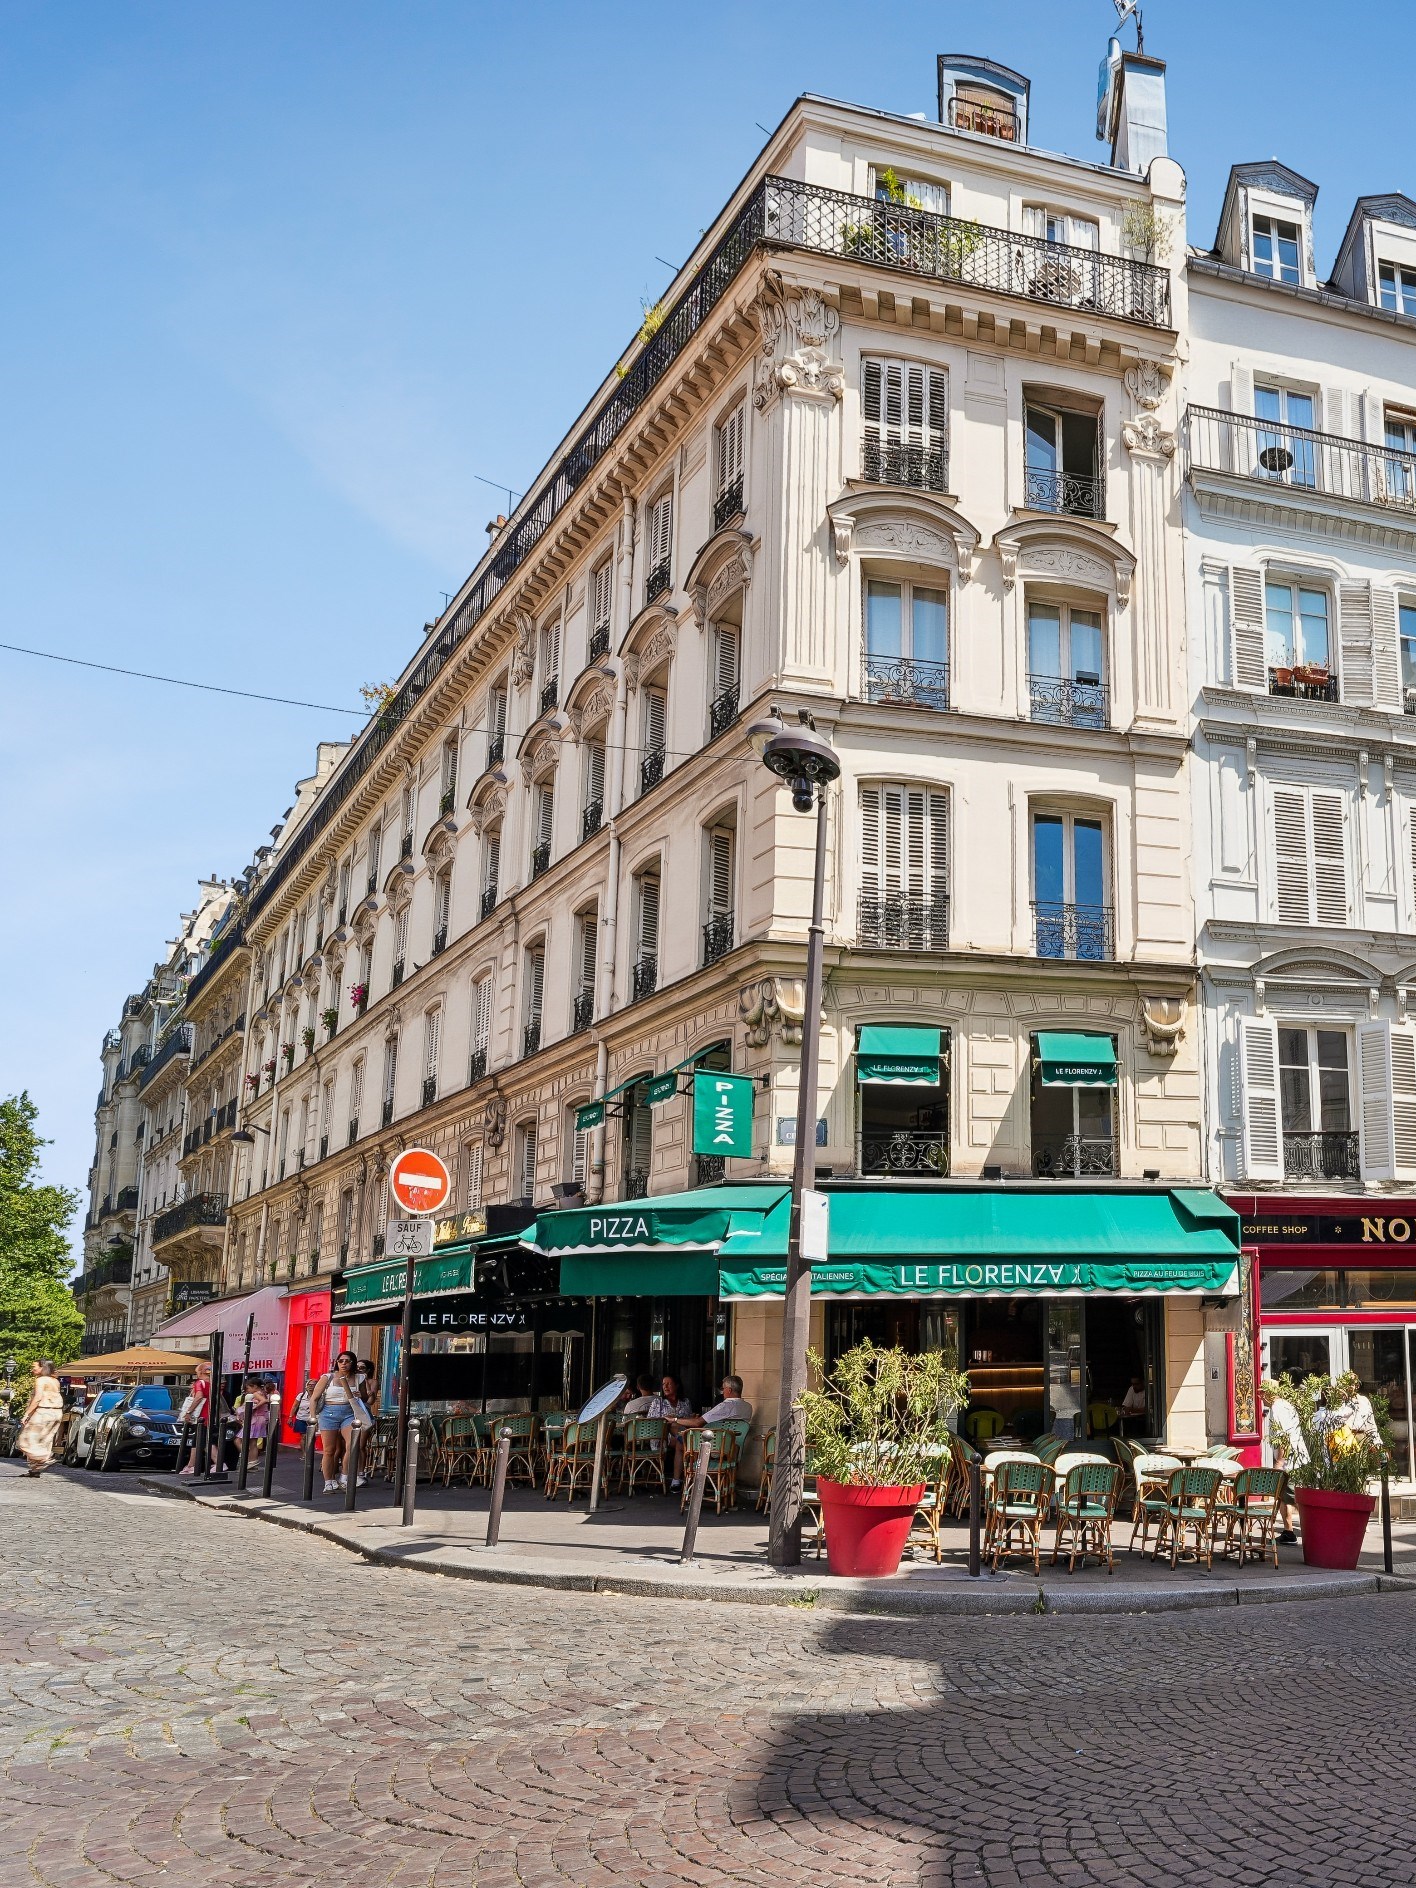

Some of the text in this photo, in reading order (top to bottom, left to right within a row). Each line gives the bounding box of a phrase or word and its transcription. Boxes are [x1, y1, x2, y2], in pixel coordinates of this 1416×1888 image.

[713, 1081, 735, 1145] PIZZA
[397, 1223, 422, 1233] SAUF
[590, 1217, 649, 1239] PIZZA
[1242, 1225, 1308, 1235] COFFEE SHOP
[901, 1265, 929, 1285] LE
[1133, 1270, 1153, 1278] PIZZA
[1153, 1270, 1164, 1278] AU
[1164, 1270, 1178, 1278] FEU
[1178, 1270, 1188, 1278] DE
[420, 1314, 437, 1325] LE
[232, 1360, 273, 1370] BACHIR
